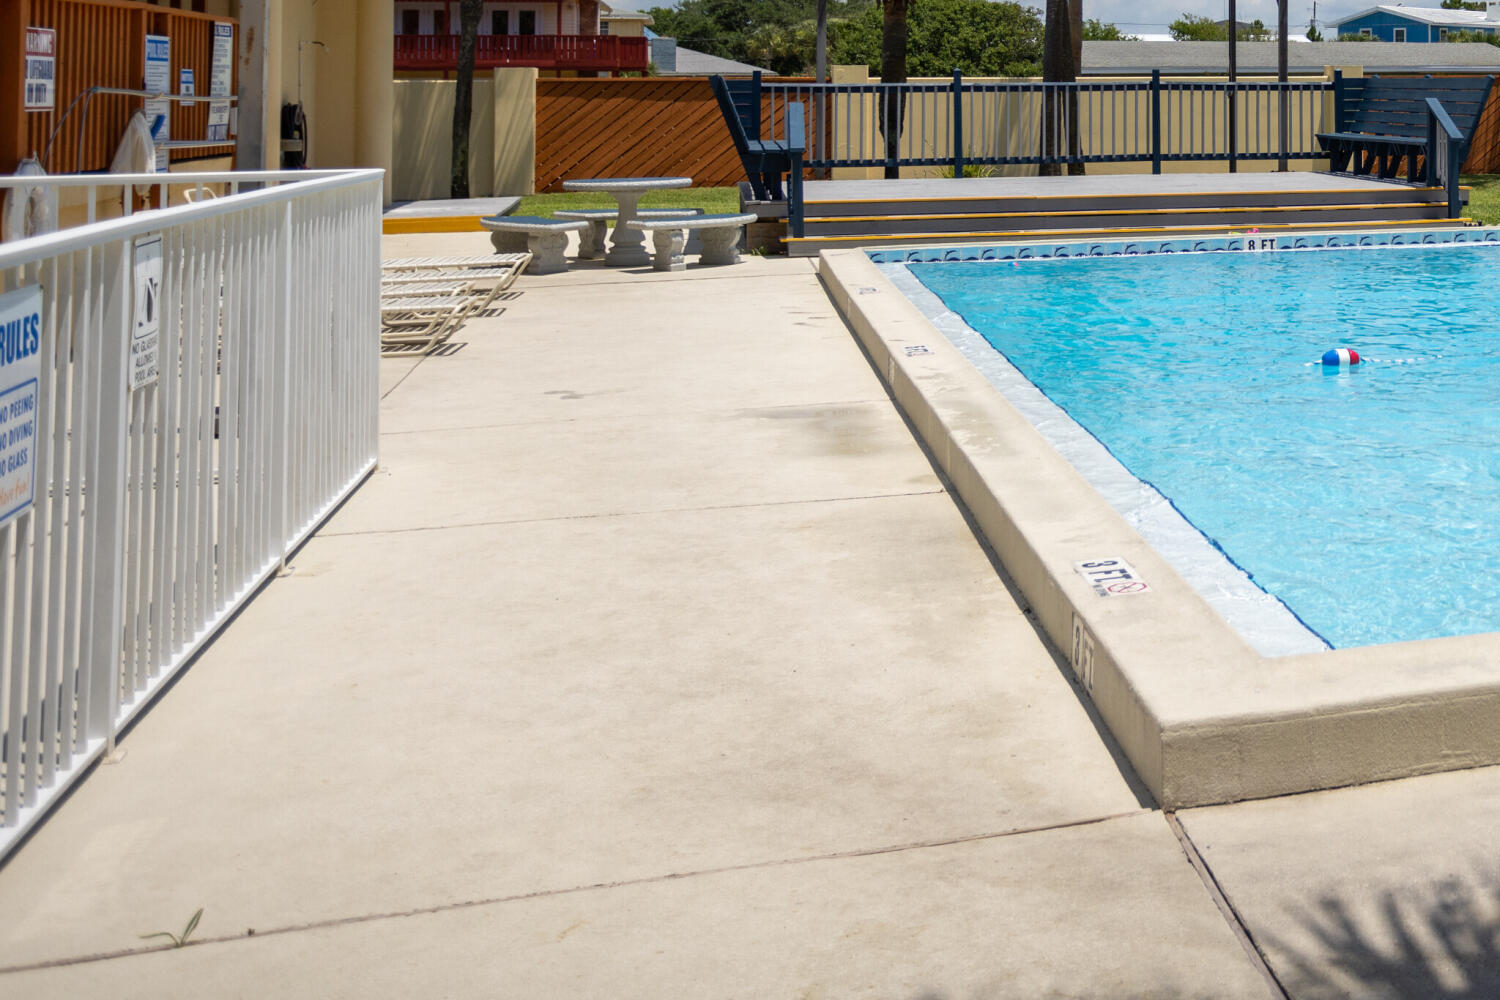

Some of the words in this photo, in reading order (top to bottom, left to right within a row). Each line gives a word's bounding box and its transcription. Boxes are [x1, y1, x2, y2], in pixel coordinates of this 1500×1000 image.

[1248, 239, 1256, 250] 8
[1261, 239, 1276, 250] FT
[0, 312, 39, 367] RULES
[131, 342, 140, 355] NO
[9, 393, 34, 420] PEEING
[9, 420, 33, 446] DIVING
[0, 459, 6, 478] O
[8, 447, 28, 473] GLASS
[1081, 560, 1119, 569] 3
[1088, 568, 1133, 583] FT
[1081, 638, 1094, 691] FT
